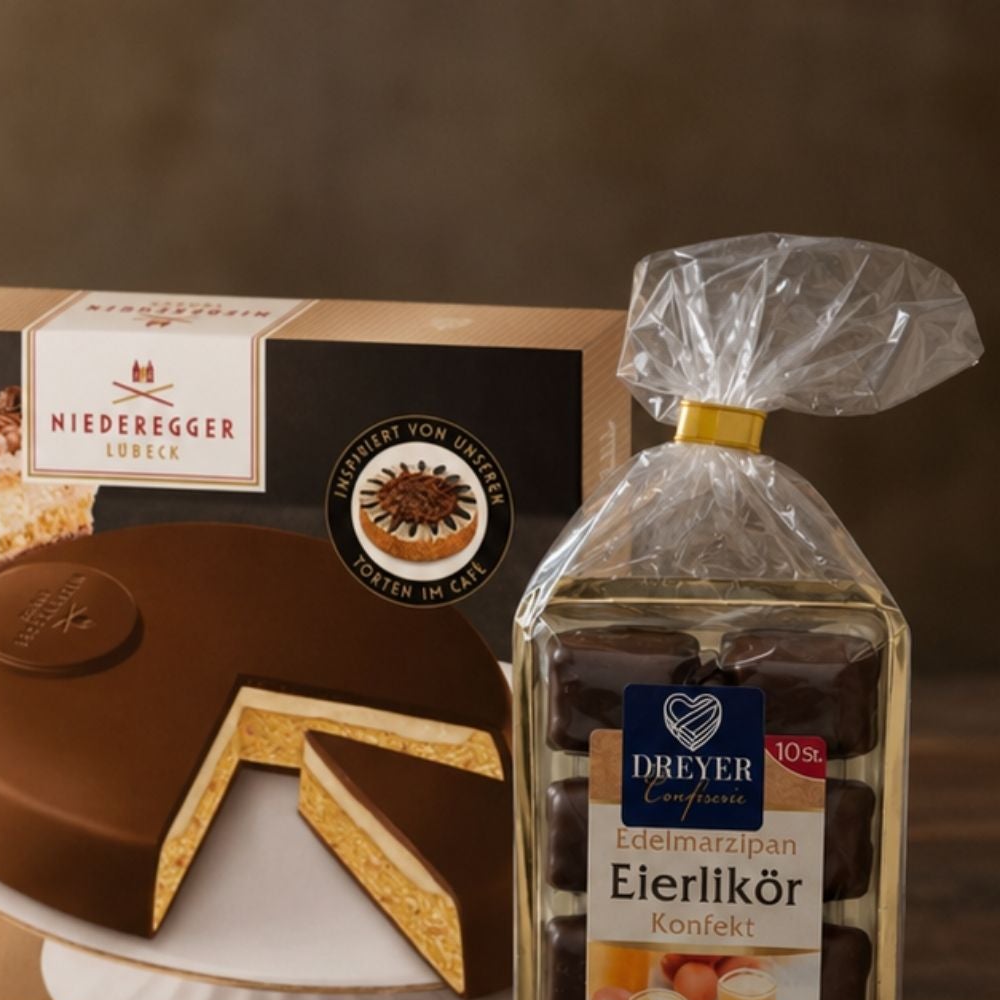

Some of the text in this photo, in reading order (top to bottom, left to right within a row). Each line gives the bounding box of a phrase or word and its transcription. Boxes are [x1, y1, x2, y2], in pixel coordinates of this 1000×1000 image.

[51, 413, 235, 439] NIEDEREGGER
[407, 423, 448, 442] VON
[106, 442, 180, 460] LÜBECK
[352, 554, 413, 598] TORTEN
[421, 586, 444, 601] IM
[774, 741, 800, 763] 10
[631, 754, 753, 782] DREYER
[616, 828, 797, 859] Edelmarzipan
[610, 863, 803, 906] Eierlikör
[650, 912, 755, 938] Konfekt
